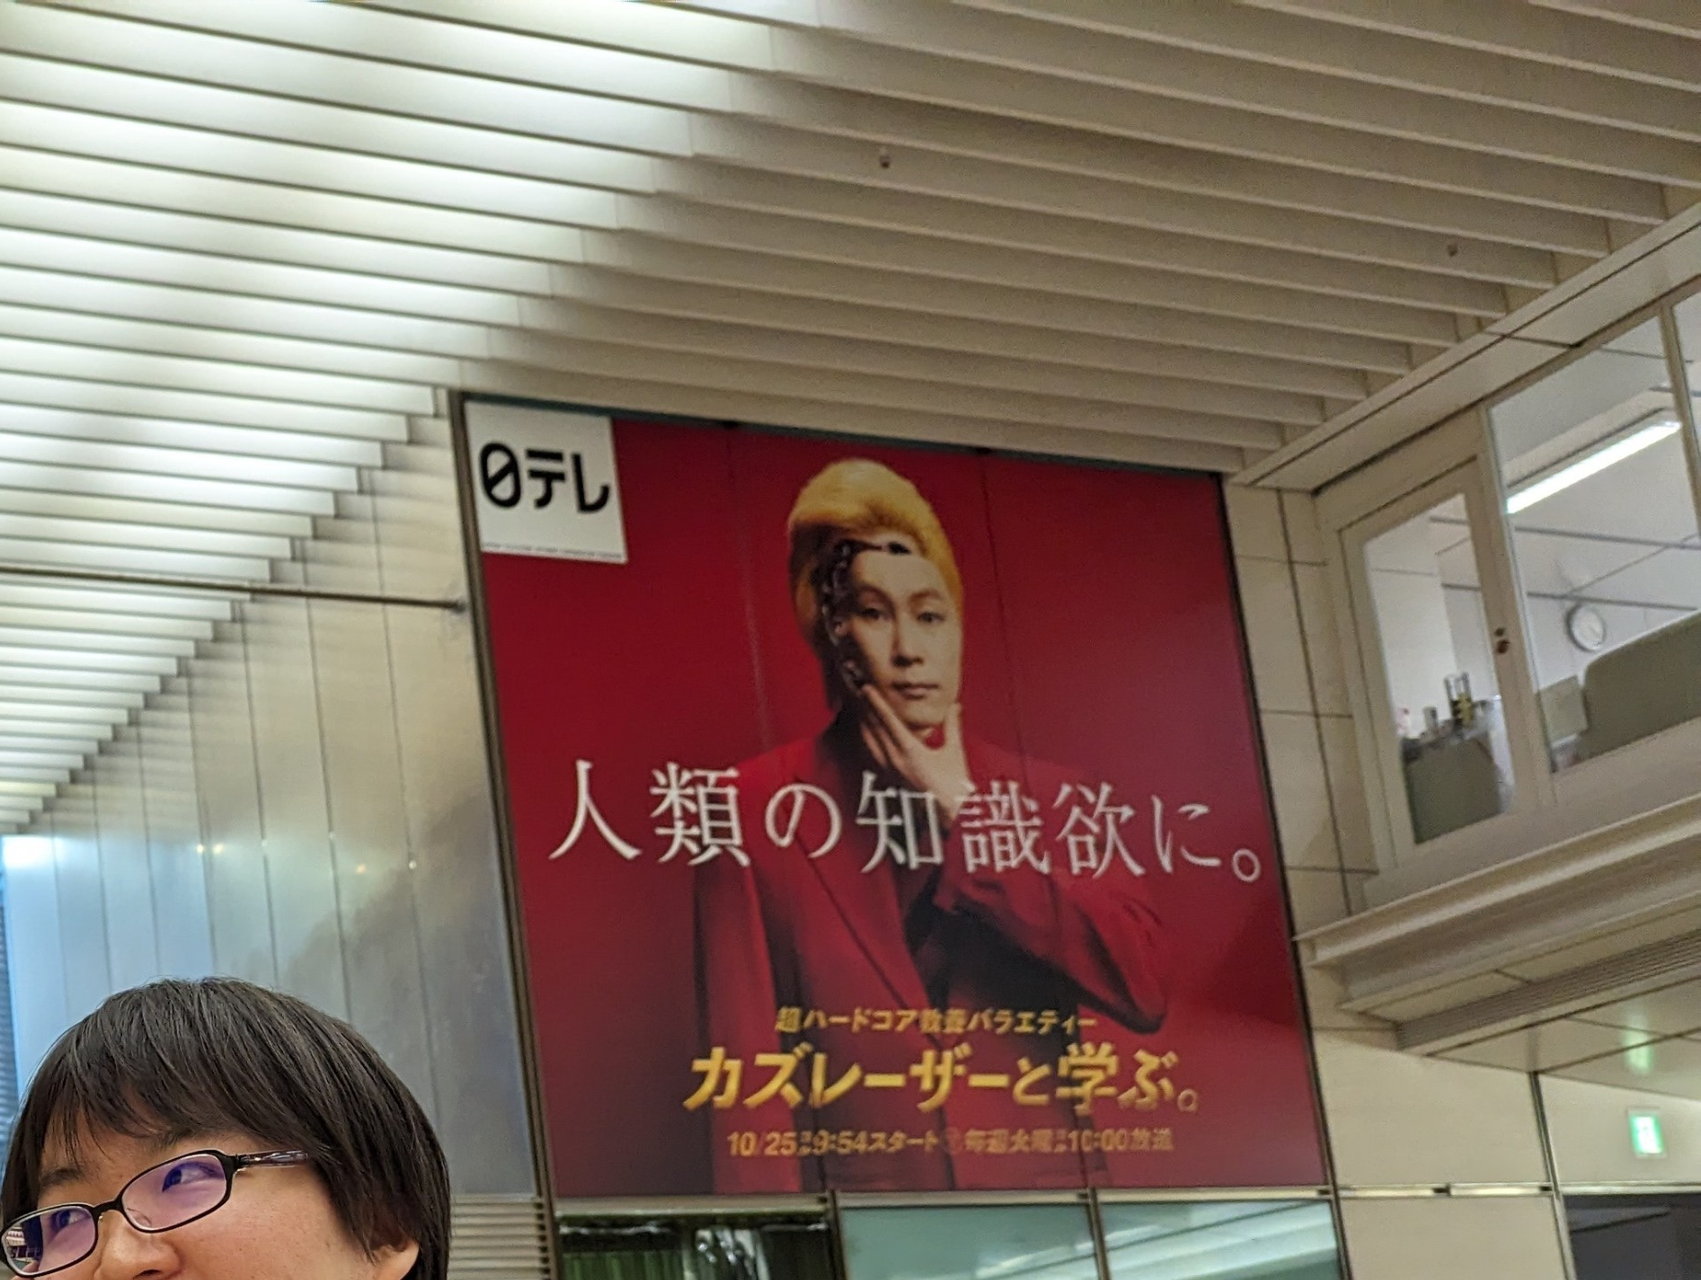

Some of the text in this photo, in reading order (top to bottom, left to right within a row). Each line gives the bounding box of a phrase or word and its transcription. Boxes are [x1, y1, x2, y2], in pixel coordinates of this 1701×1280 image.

[479, 442, 610, 513] 日テレ
[547, 758, 1262, 883] 人類の知識欲に。
[683, 1042, 1200, 1116] カズレーザーと学ぶ。
